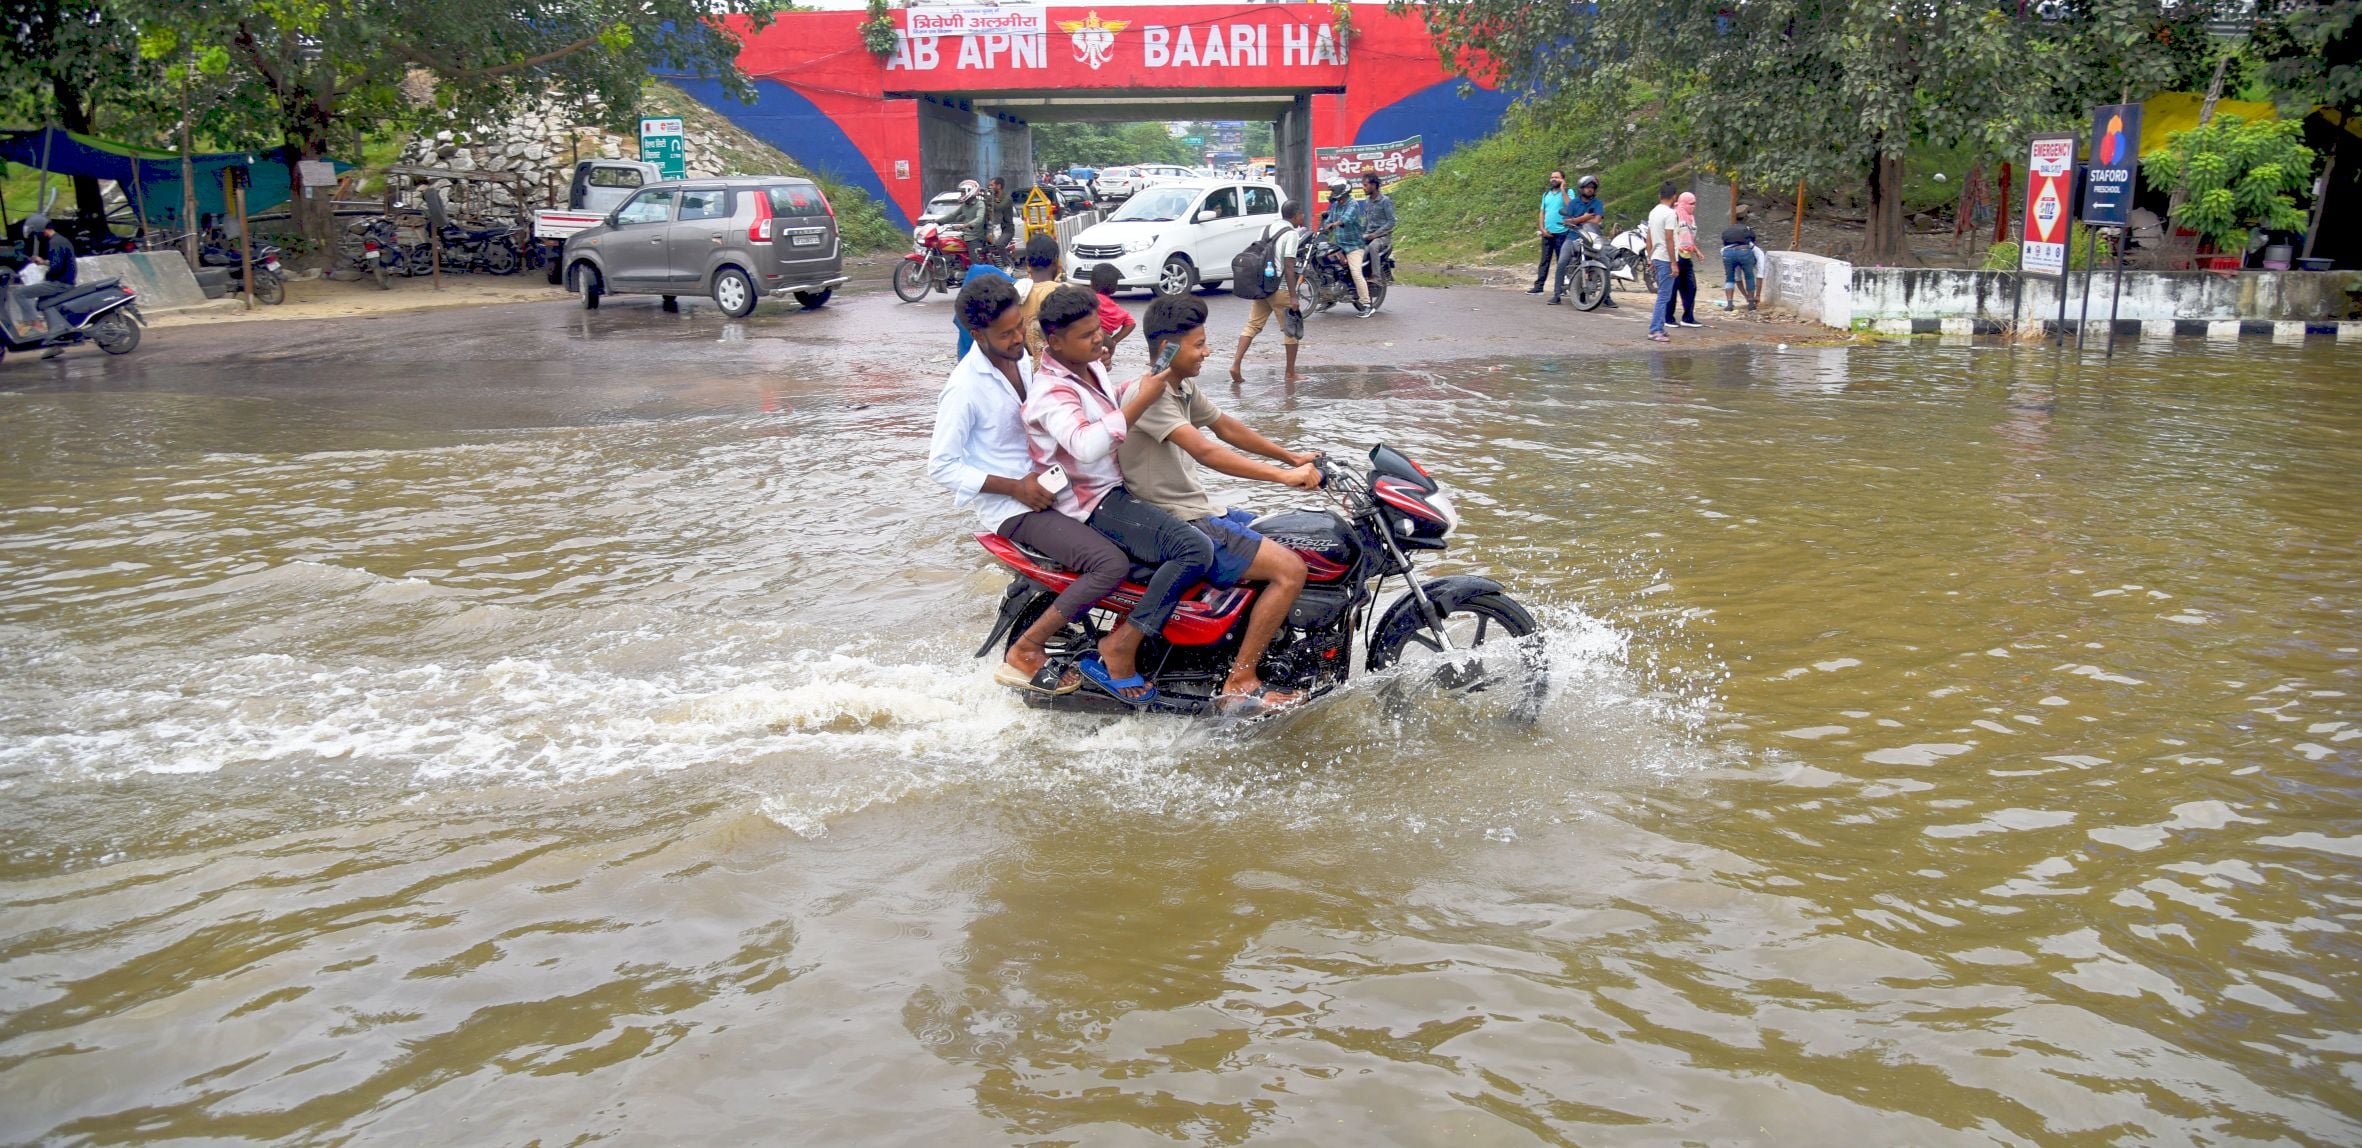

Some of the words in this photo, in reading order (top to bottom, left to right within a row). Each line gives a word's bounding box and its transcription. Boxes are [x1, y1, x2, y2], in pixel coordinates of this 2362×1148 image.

[913, 14, 964, 29] त्रिवेणी
[969, 13, 1038, 28] अलमीरा
[886, 29, 940, 70] AB
[956, 34, 1048, 70] APNI
[1143, 24, 1268, 67] BAARI
[2033, 143, 2072, 157] EMERGENCY
[2090, 169, 2128, 182] STAFORD
[2093, 185, 2121, 194] PRESCHOOL
